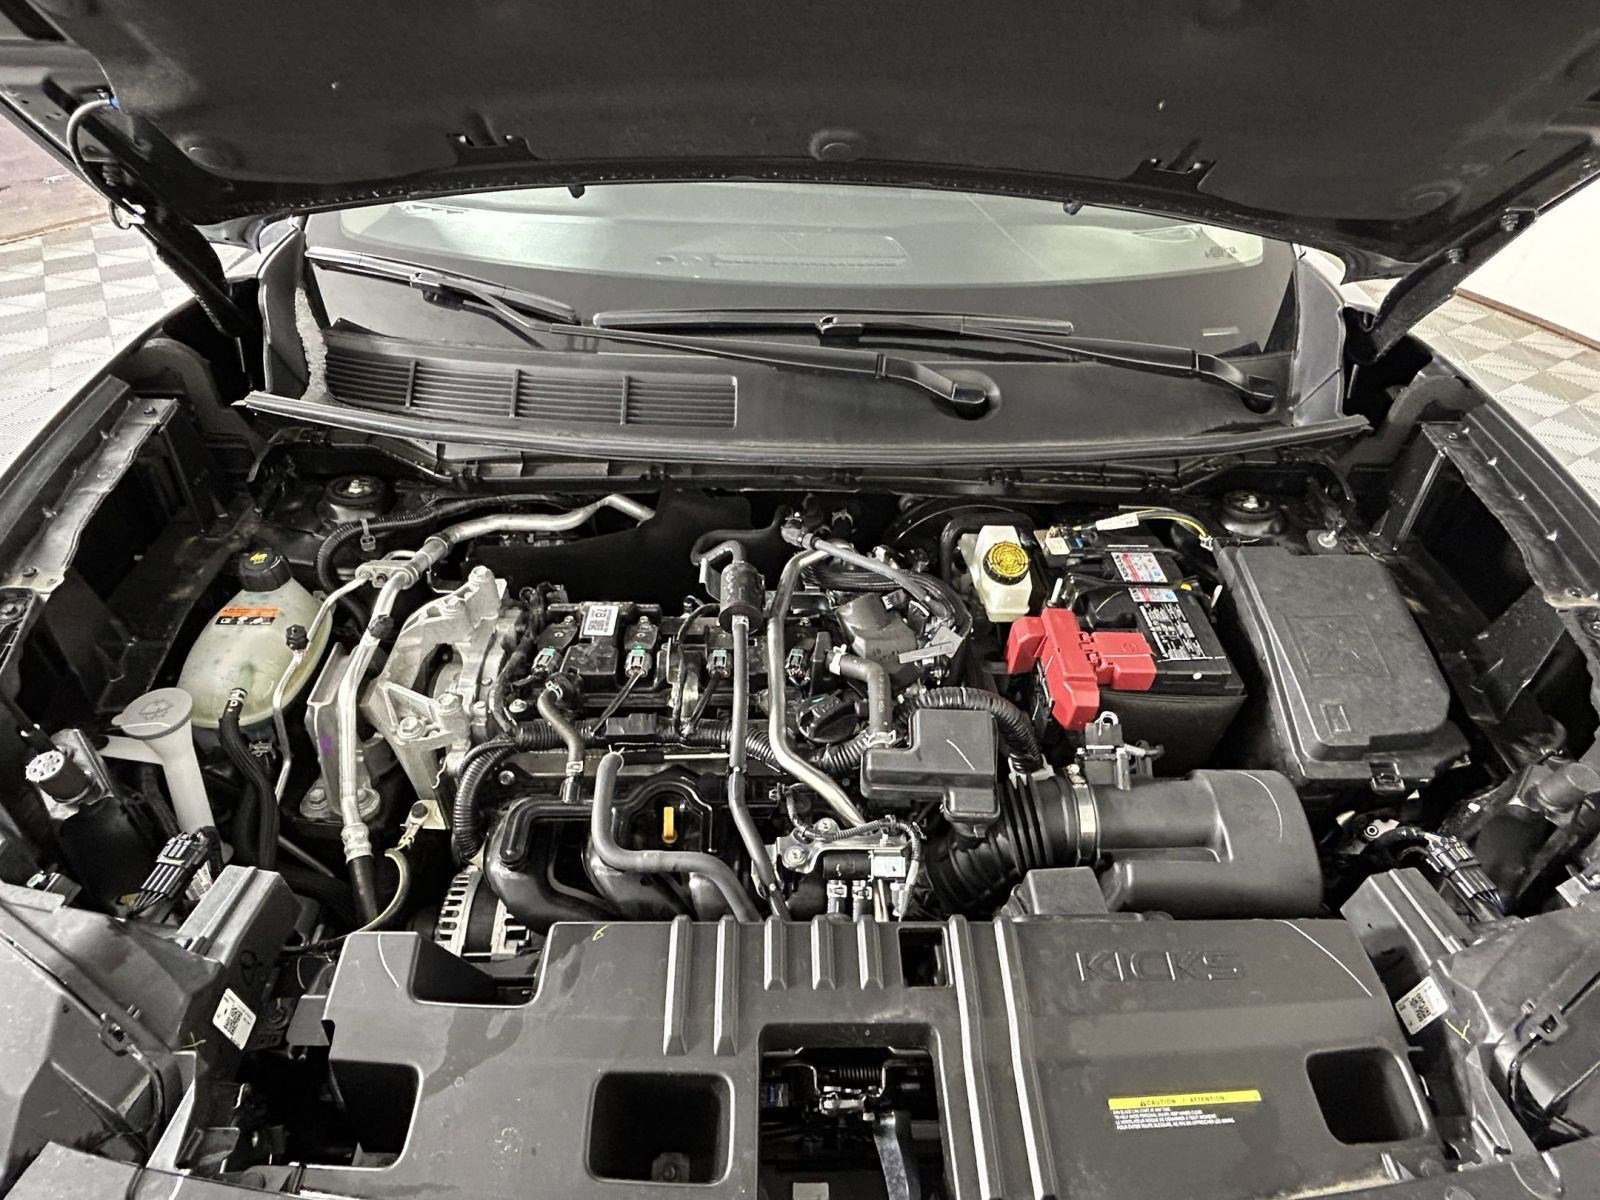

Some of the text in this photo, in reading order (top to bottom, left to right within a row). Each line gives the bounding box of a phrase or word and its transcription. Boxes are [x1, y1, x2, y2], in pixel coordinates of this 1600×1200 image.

[1076, 951, 1244, 981] KICKS
[1146, 1098, 1177, 1106] CAUTION
[1189, 1095, 1225, 1103] ATTENTION
